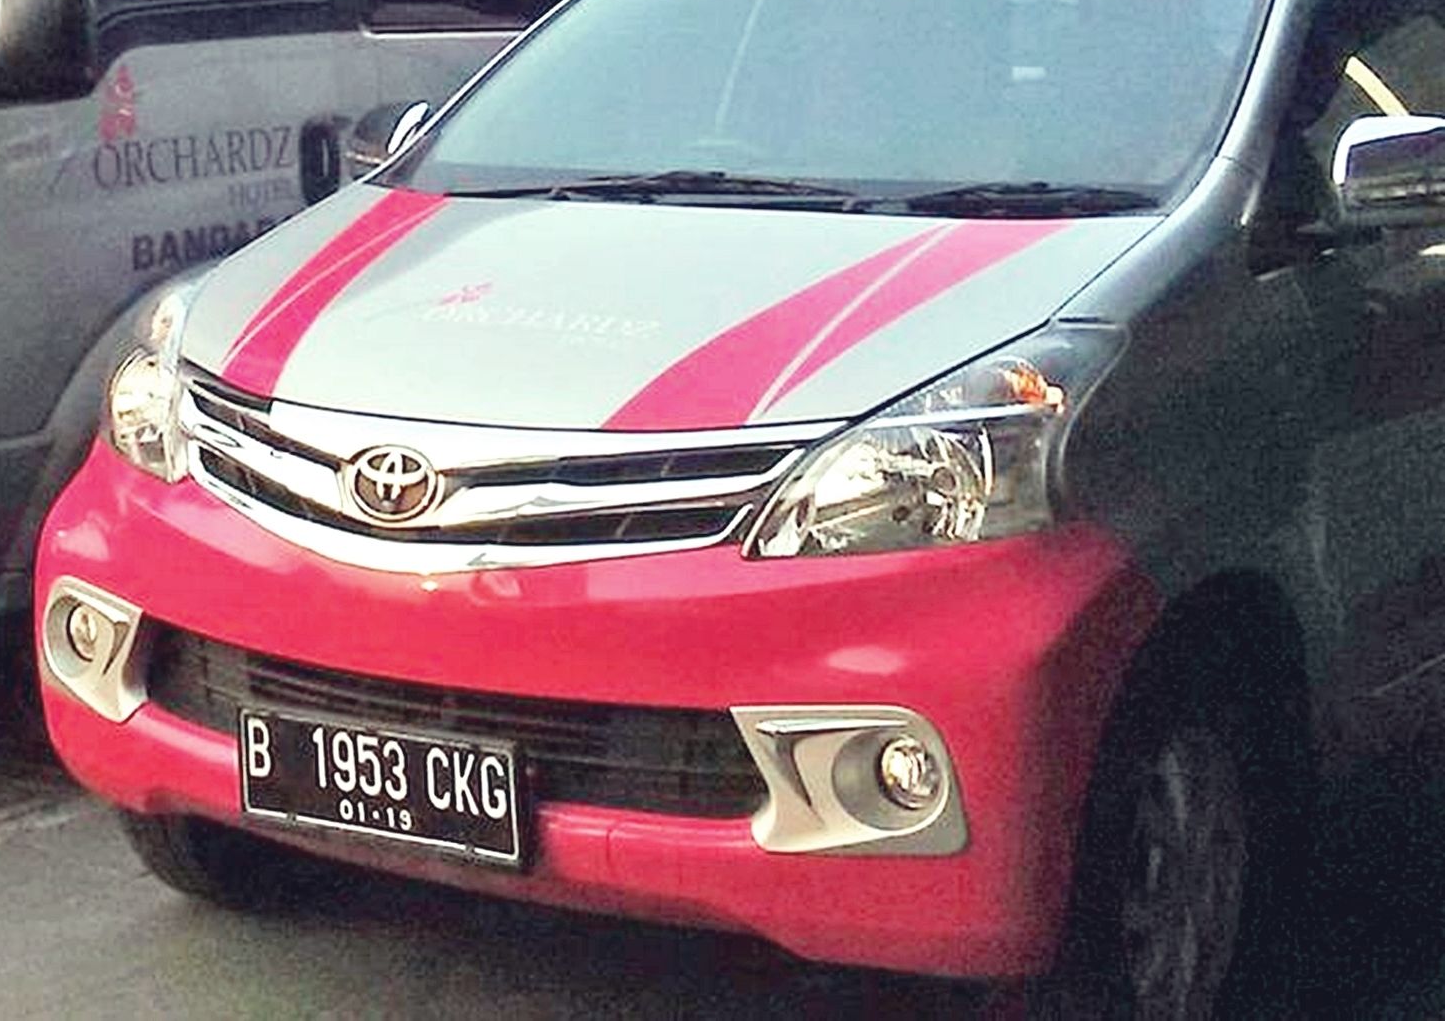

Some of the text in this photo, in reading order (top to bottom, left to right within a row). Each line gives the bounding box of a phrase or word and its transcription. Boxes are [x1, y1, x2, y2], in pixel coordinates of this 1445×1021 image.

[93, 125, 296, 190] ORCHARDZ
[247, 716, 507, 820] B 1953 CKG
